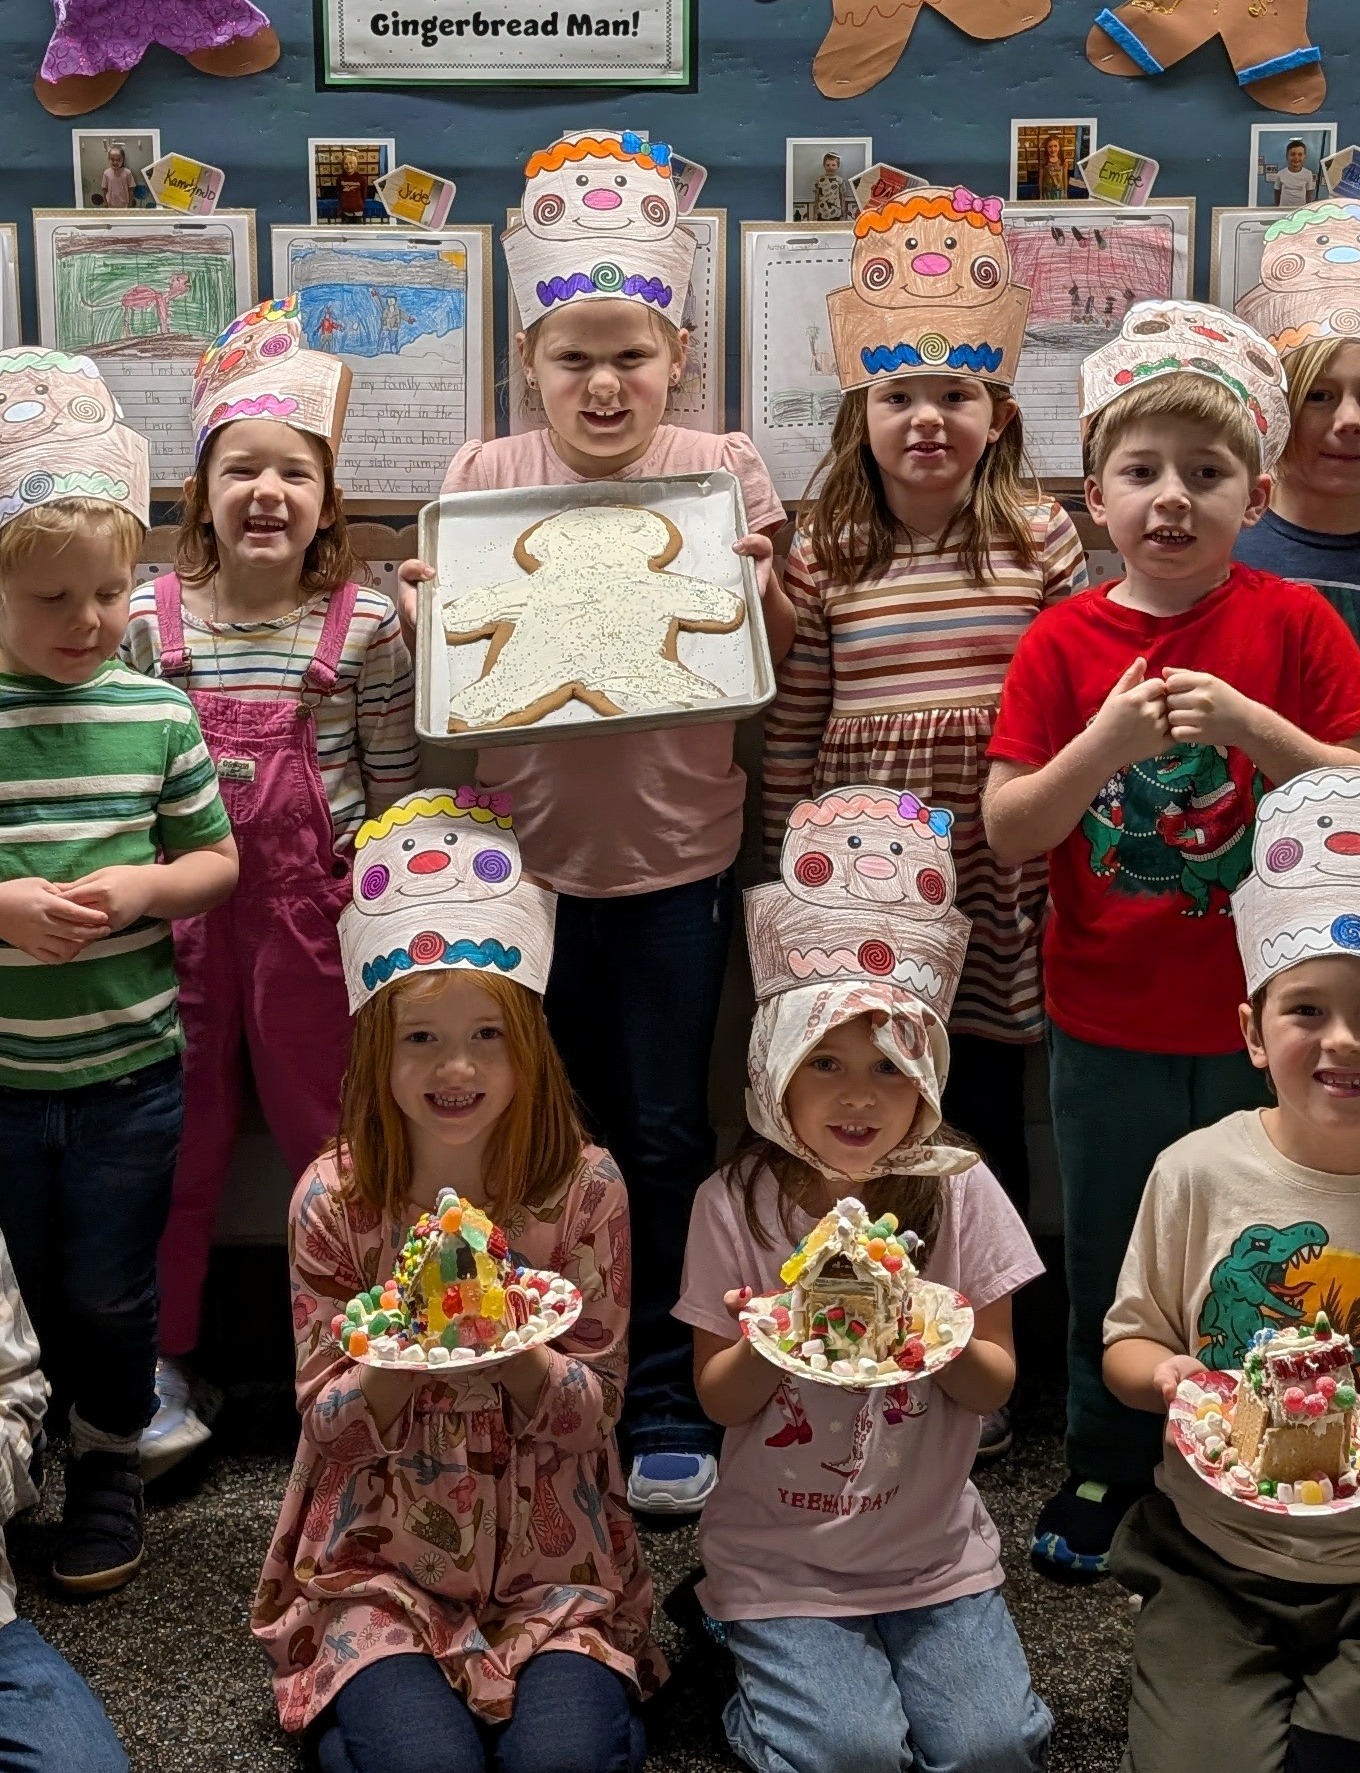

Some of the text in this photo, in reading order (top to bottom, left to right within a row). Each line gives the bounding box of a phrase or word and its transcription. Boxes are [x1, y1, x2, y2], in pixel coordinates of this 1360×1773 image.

[370, 10, 640, 47] Gingerbread Man!
[398, 182, 431, 206] Jude
[777, 1487, 853, 1516] YEEHAW
